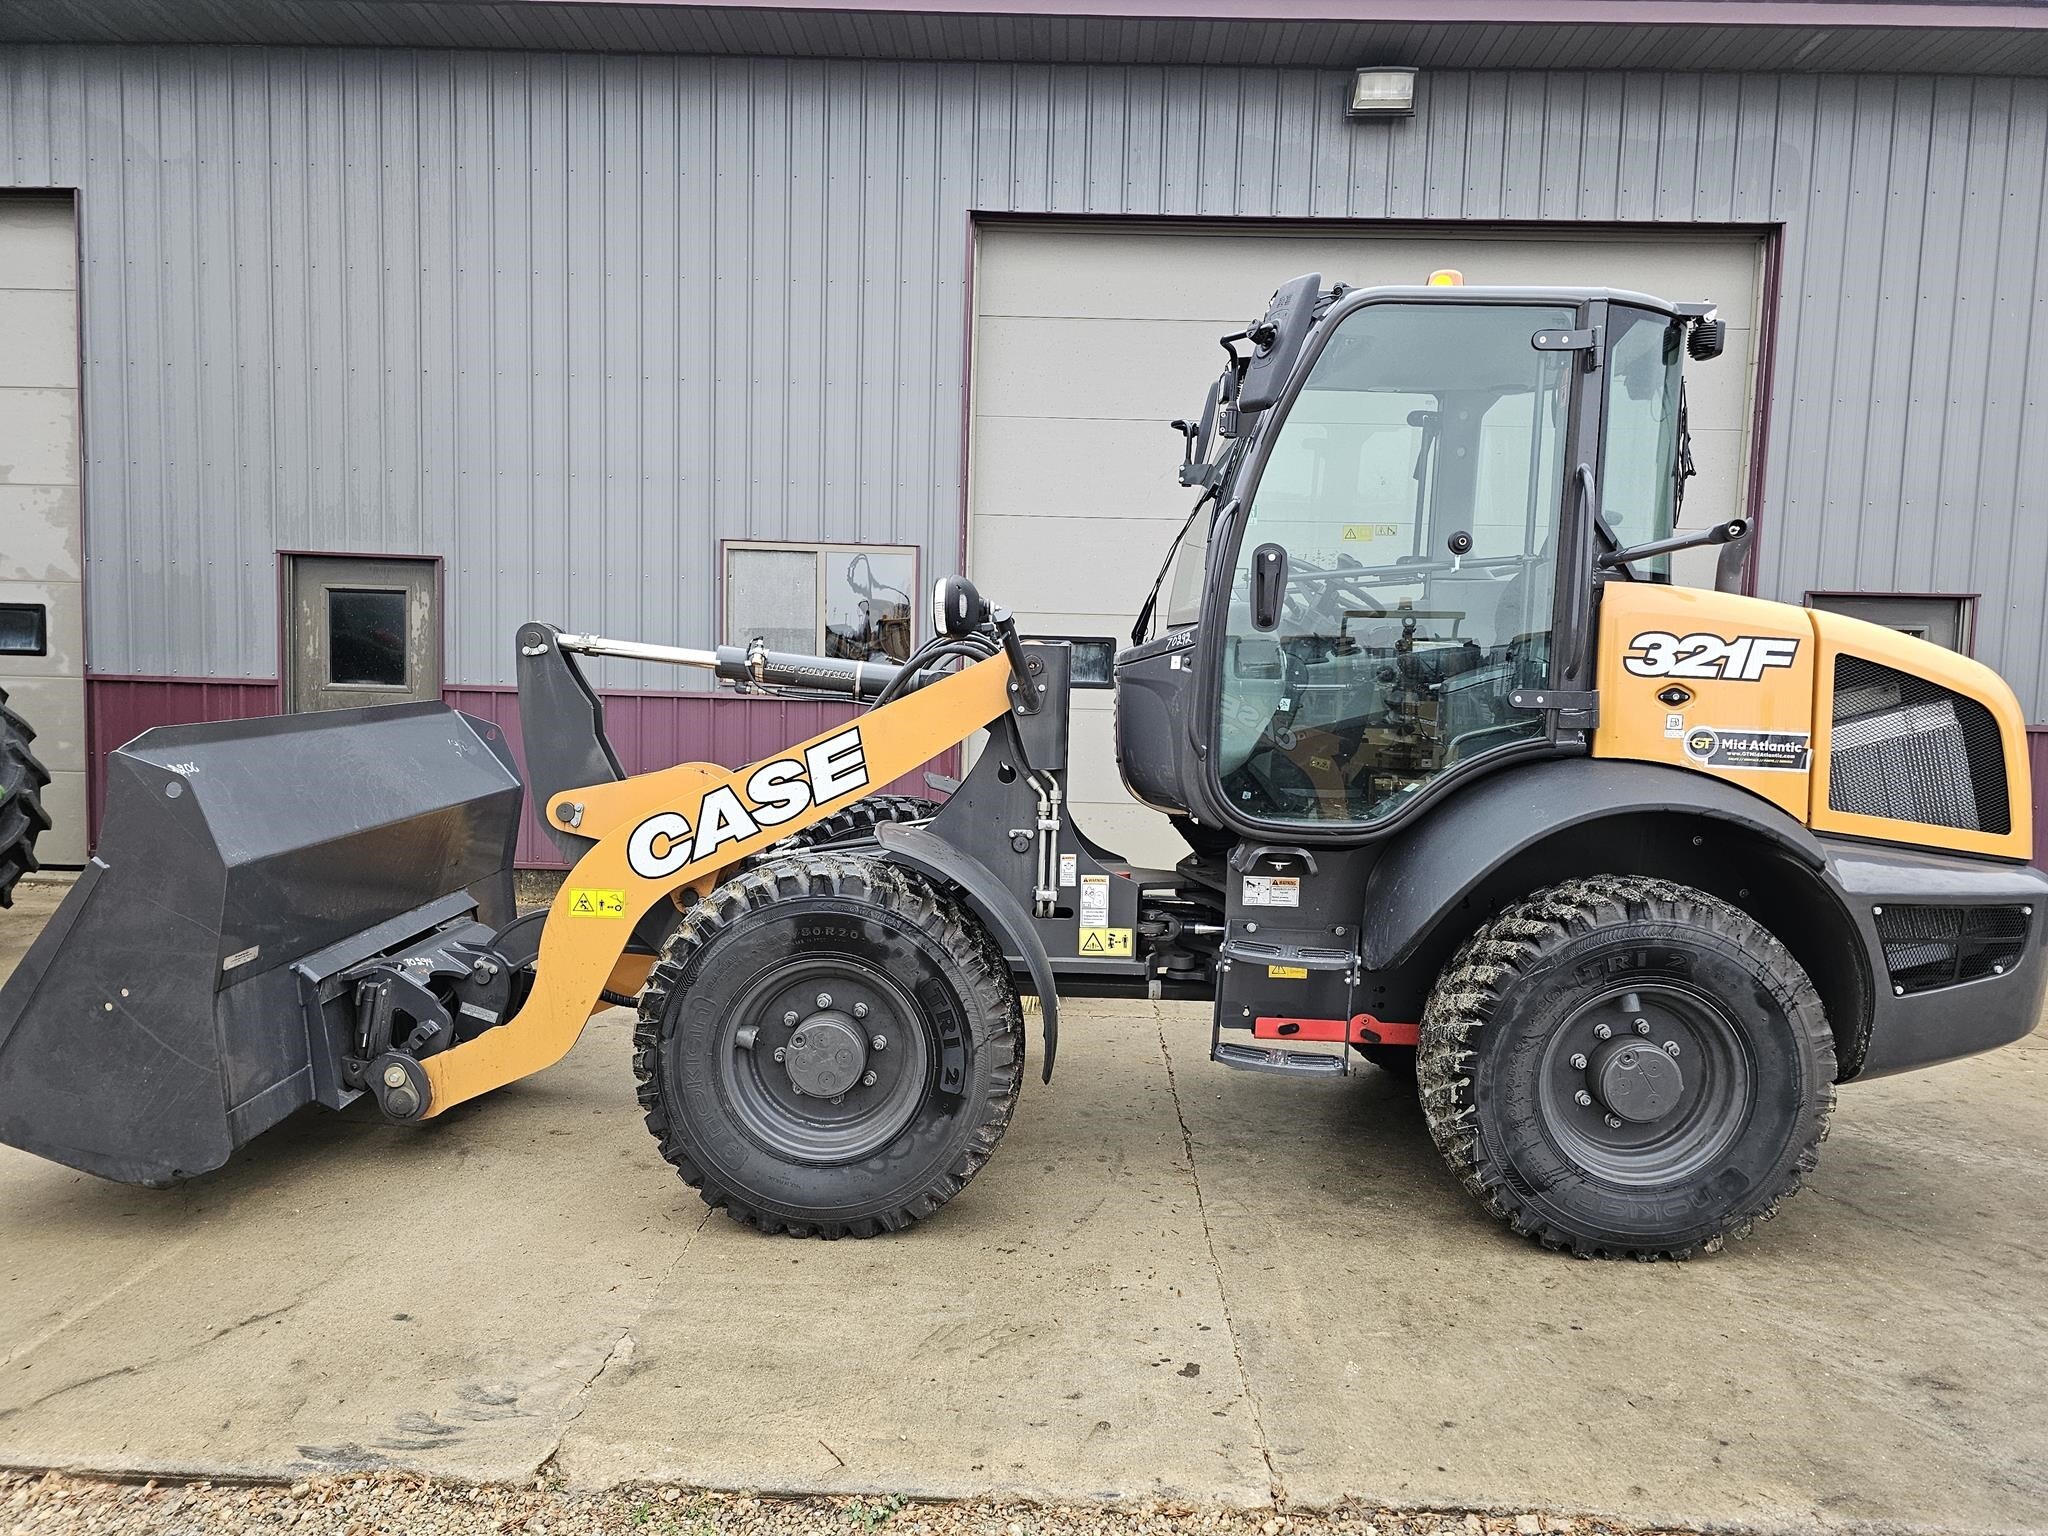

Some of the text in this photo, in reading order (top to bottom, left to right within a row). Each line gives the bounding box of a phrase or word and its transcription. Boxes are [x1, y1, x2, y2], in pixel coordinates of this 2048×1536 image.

[798, 665, 857, 681] CONTROL
[1623, 631, 1800, 682] 321F
[1691, 737, 1713, 750] GT
[1721, 738, 1803, 753] Mid Atlantic
[627, 726, 869, 879] CASE
[1581, 949, 1689, 985] TRI 2
[928, 987, 961, 1086] TRI 2
